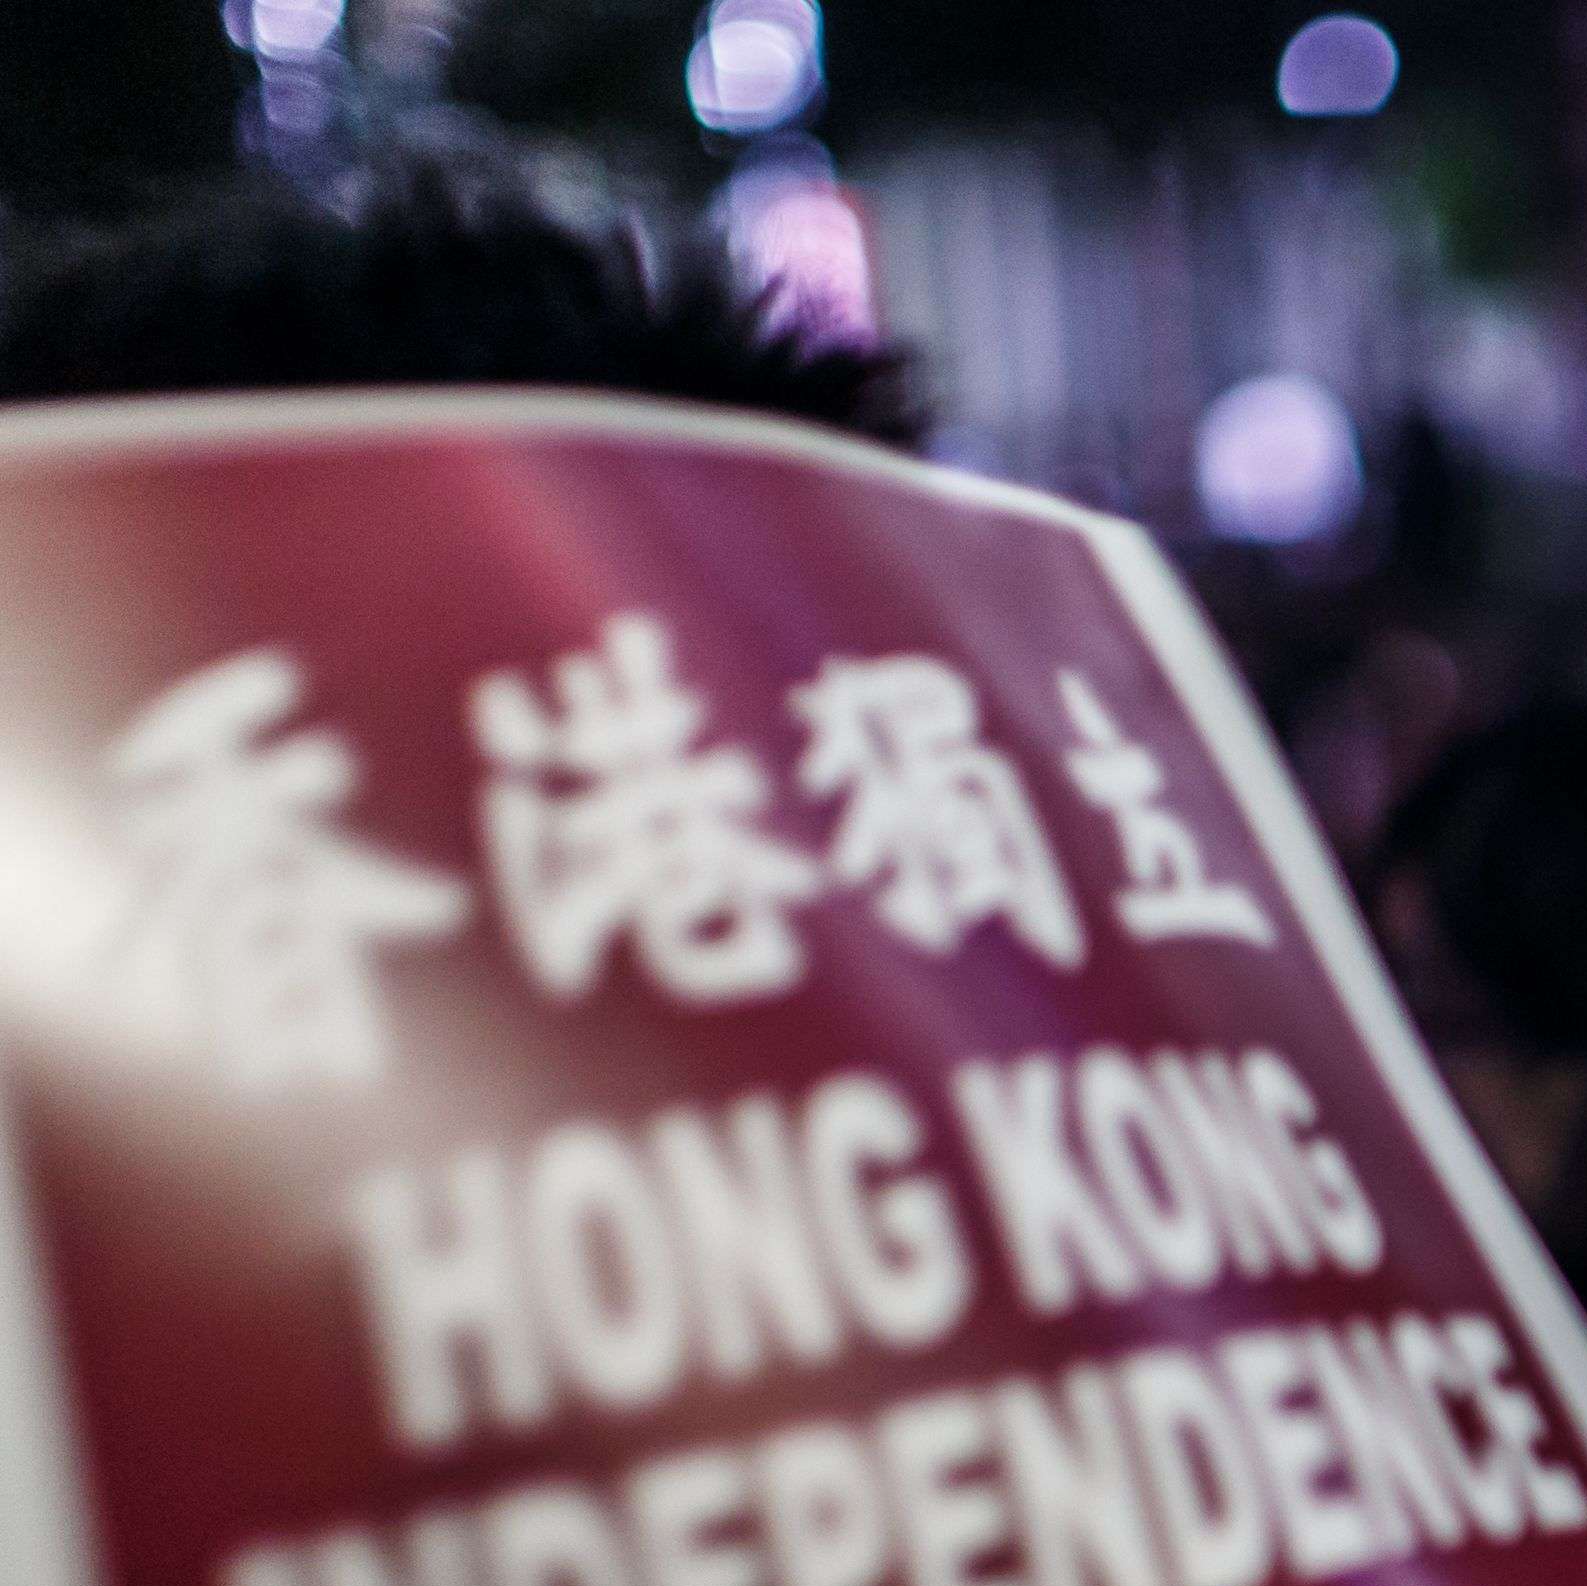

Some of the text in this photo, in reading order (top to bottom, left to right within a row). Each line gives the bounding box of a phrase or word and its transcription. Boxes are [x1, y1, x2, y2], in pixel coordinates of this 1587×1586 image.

[98, 612, 1274, 1092] 香港獨立
[350, 1045, 1382, 1452] HONG KONG
